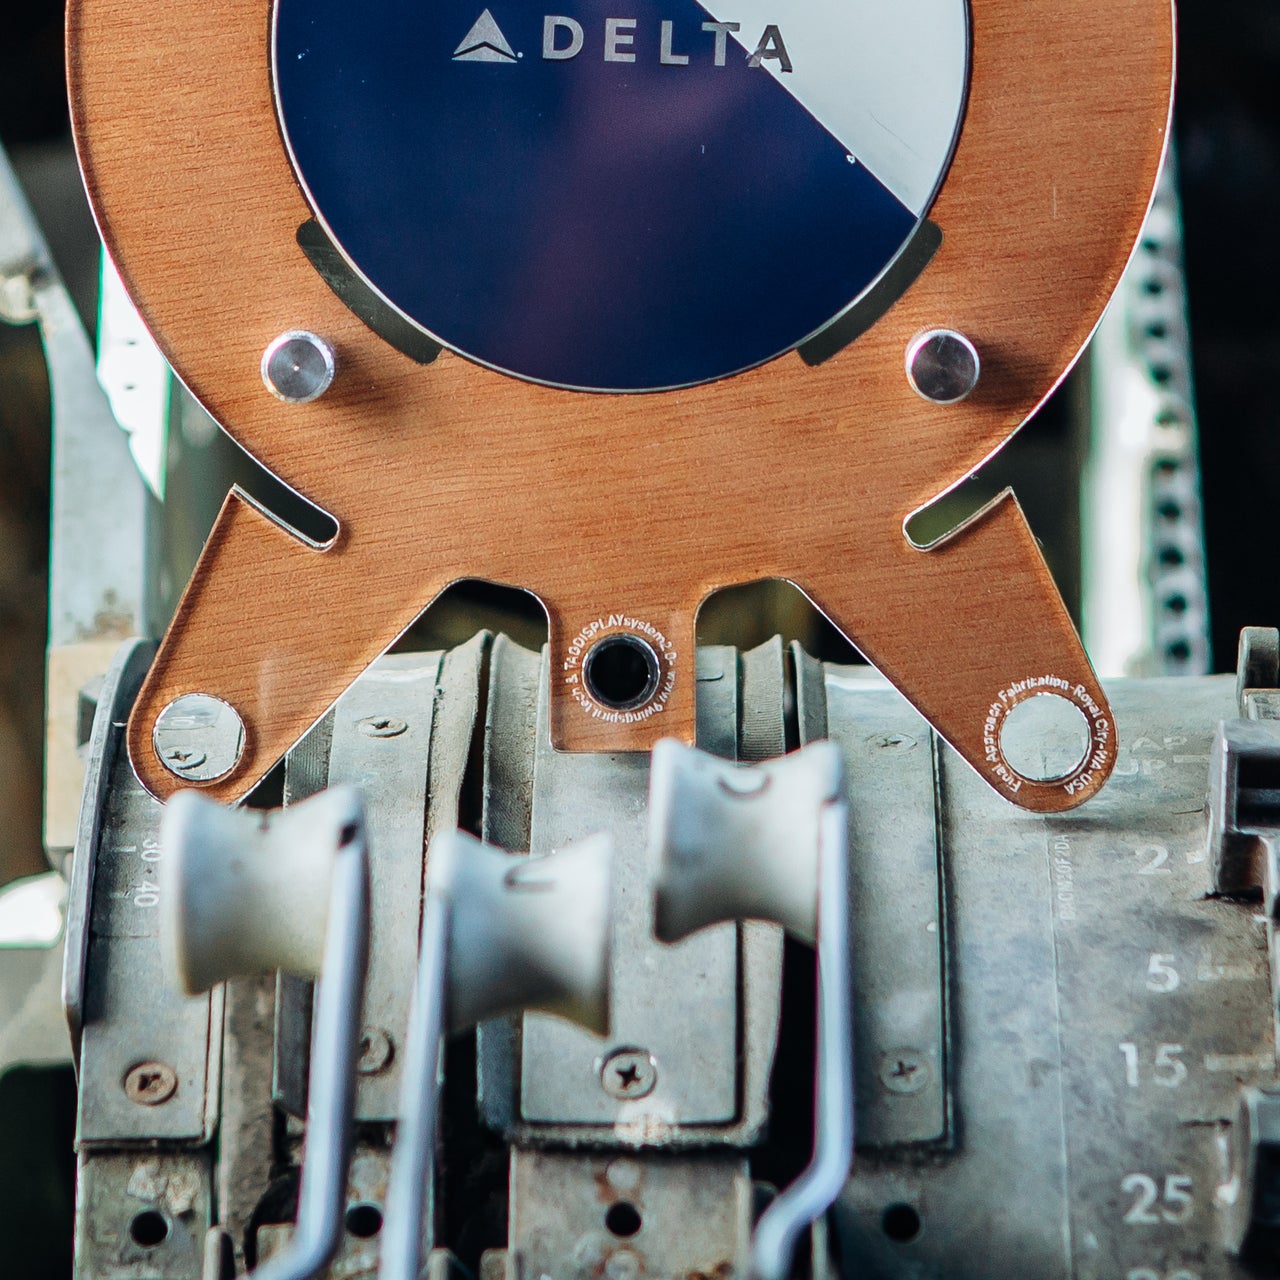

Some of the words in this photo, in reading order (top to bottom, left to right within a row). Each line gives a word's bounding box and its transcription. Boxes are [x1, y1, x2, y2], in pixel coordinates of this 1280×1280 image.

[542, 14, 794, 73] DELTA
[991, 763, 1022, 793] Final
[1134, 845, 1172, 875] 2
[133, 880, 161, 908] 40
[1145, 952, 1180, 993] 5
[1118, 1042, 1188, 1088] 15
[1121, 1172, 1195, 1225] 25
